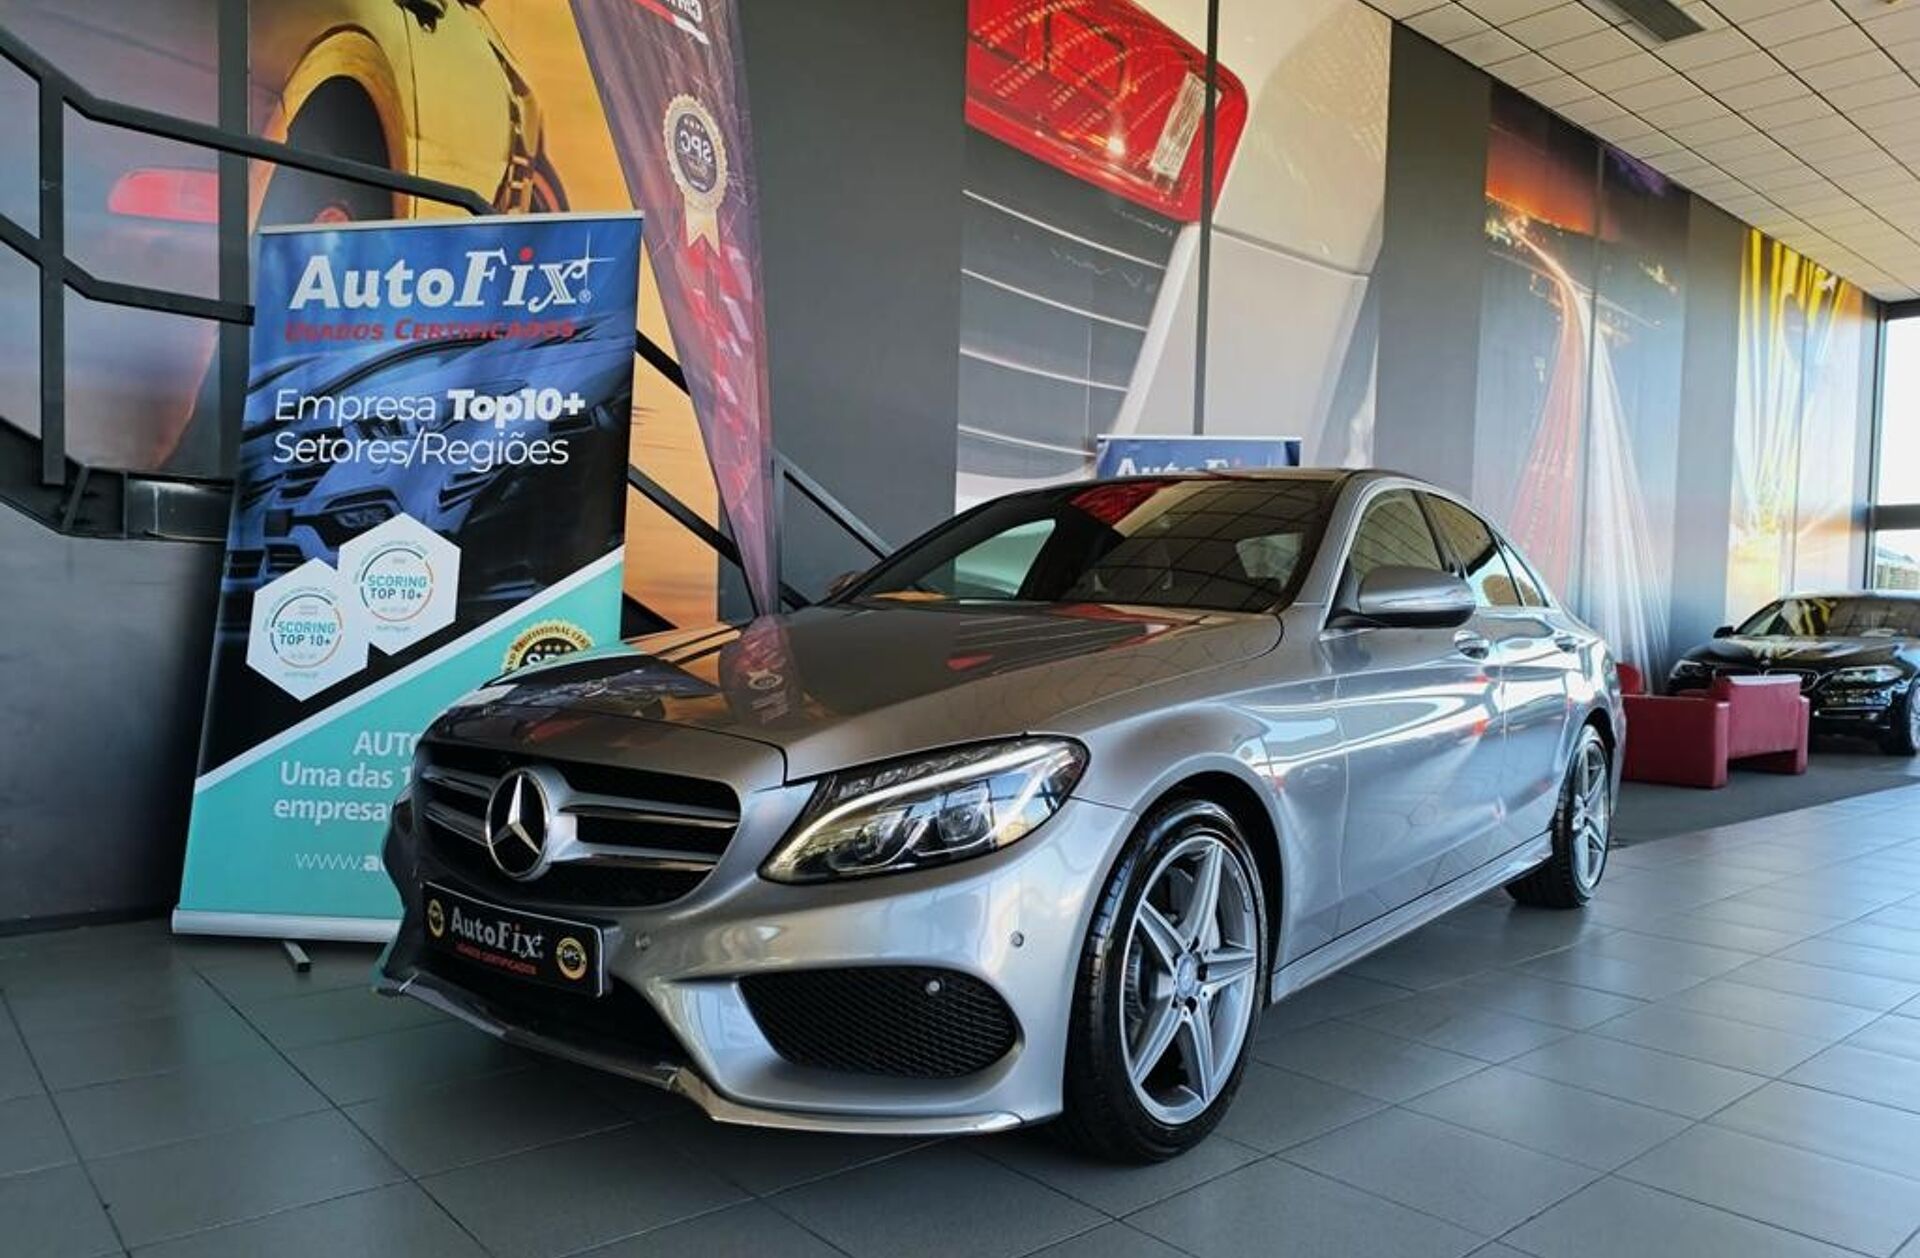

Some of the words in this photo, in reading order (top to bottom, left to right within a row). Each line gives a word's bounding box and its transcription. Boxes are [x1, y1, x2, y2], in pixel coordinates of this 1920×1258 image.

[394, 317, 577, 341] CERTIFICADOS
[274, 387, 436, 432] Empresa
[447, 387, 586, 428] Top10+
[273, 429, 570, 472] Setores/Regiões
[366, 574, 428, 589] SCORING
[369, 587, 397, 600] TOP
[400, 588, 424, 600] 10+
[277, 620, 337, 634] SCORING
[279, 633, 305, 645] TOP
[309, 634, 331, 646] 10+
[280, 760, 341, 788] Uma
[346, 762, 393, 789] das
[273, 796, 393, 826] empresa
